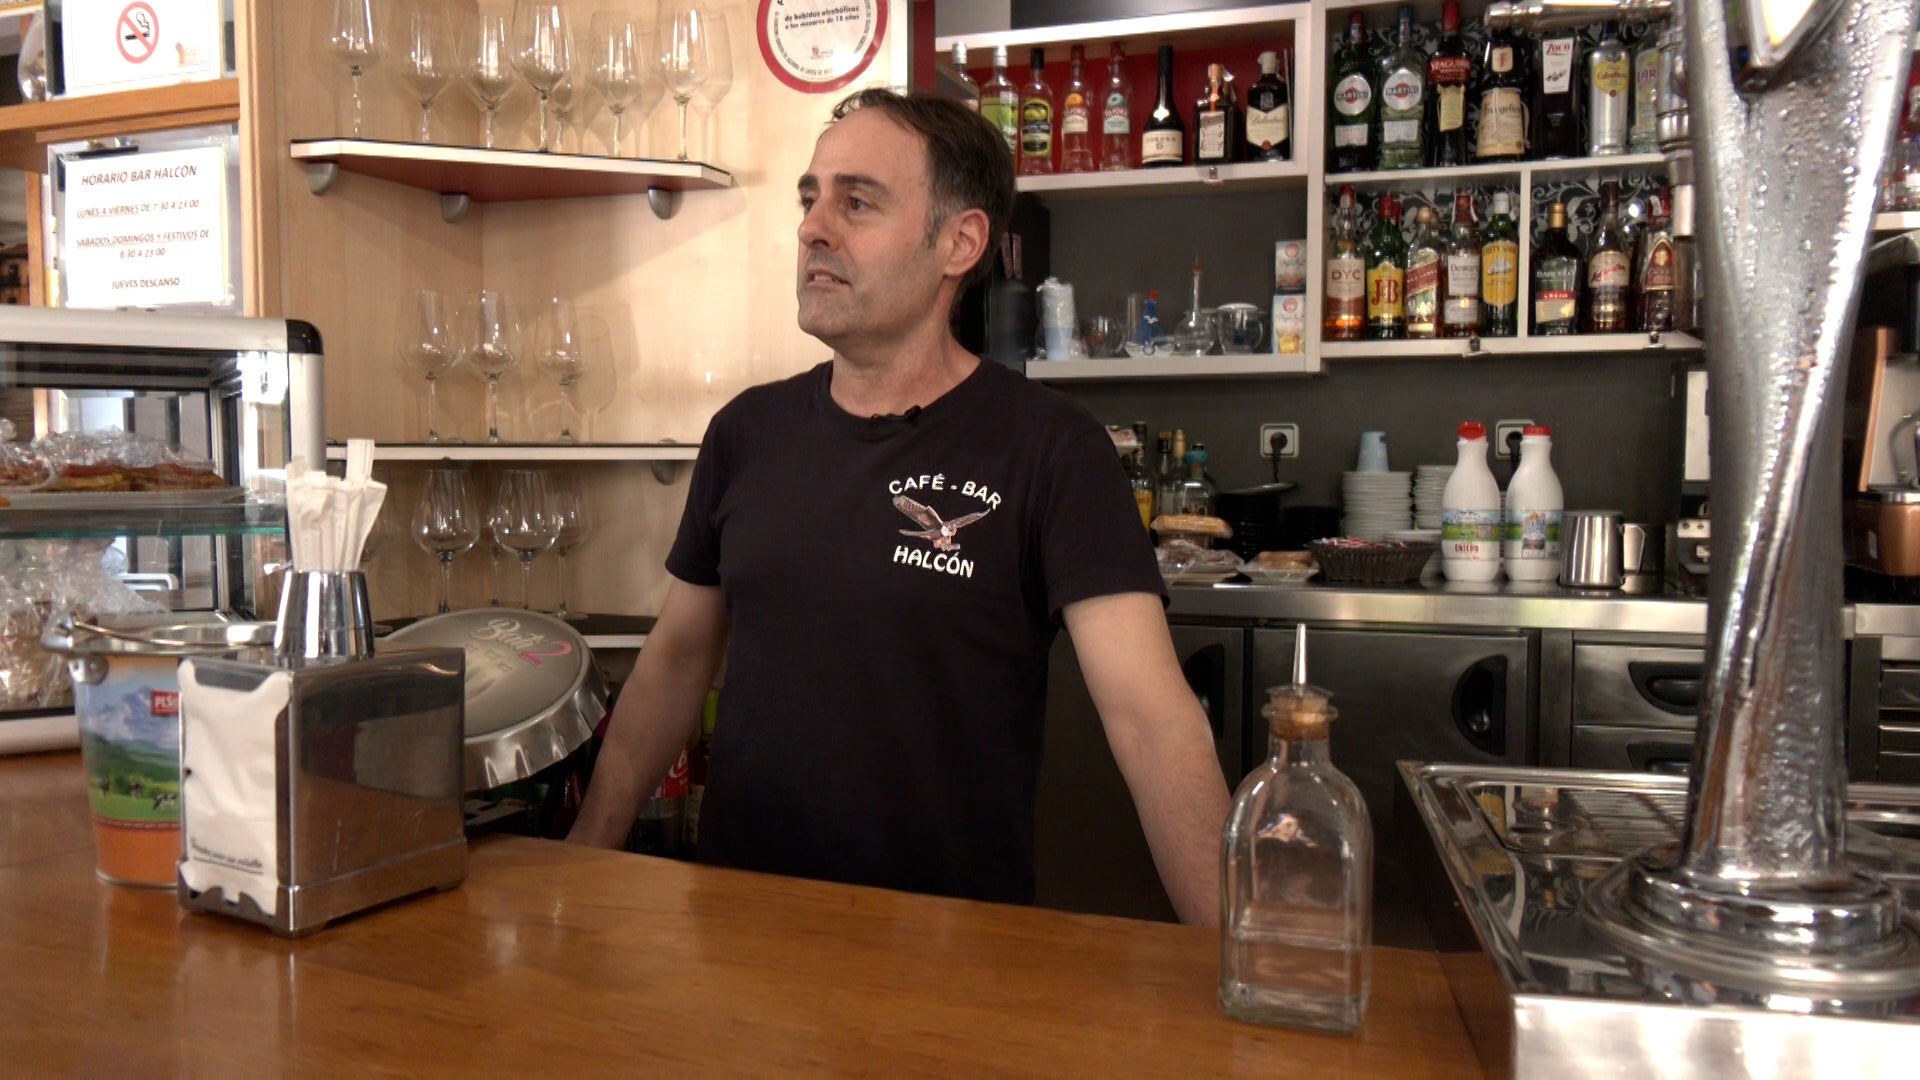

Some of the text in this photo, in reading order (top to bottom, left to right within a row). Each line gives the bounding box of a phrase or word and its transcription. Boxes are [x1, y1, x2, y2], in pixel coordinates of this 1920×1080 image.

[81, 171, 128, 187] HORARIO
[130, 169, 152, 182] BAR
[77, 208, 100, 218] LUNES
[108, 204, 139, 215] VIERNES
[140, 203, 150, 212] DE
[163, 230, 198, 242] FESTIVOS
[199, 229, 210, 239] DE
[1331, 269, 1361, 280] DYC
[111, 277, 181, 290] JUEVES DESCANSO
[889, 473, 946, 495] CAFÉ
[961, 481, 1002, 510] BAR
[893, 545, 974, 578] HALCÓN
